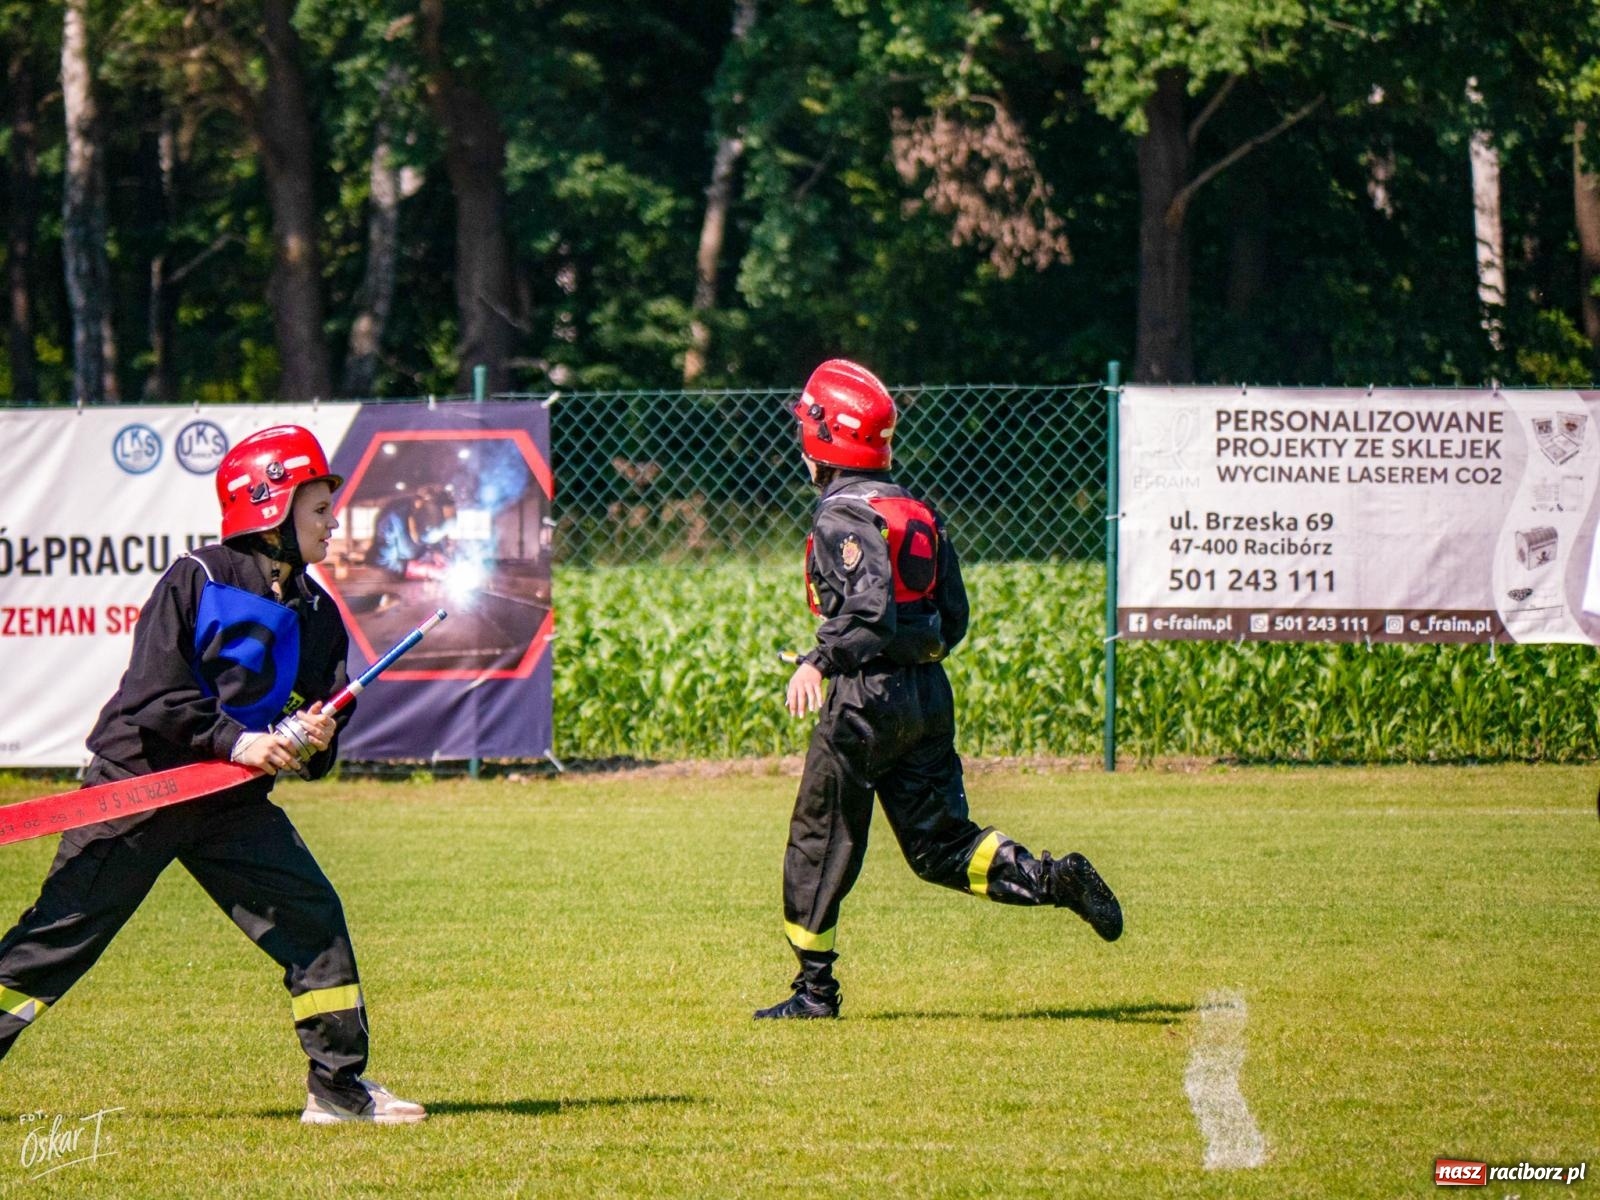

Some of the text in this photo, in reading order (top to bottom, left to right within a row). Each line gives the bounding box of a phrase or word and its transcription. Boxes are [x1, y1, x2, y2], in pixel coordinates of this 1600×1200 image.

[1215, 409, 1504, 433] PERSONALIZOWANE
[120, 427, 156, 458] LKS
[181, 424, 225, 457] UKS
[1216, 437, 1502, 459] PROJEKTY ZE SKLEJEK
[1216, 465, 1502, 485] WYCINANE LASEREM CO2
[1170, 510, 1334, 531] ul. Brzeska 69
[1169, 537, 1333, 555] 47-400 Racibórz
[1169, 569, 1335, 592] 501 243 111
[1153, 614, 1233, 633] e-fraim.pl
[1274, 616, 1369, 632] 501 243 111
[1410, 616, 1492, 635] e_fraim.pl
